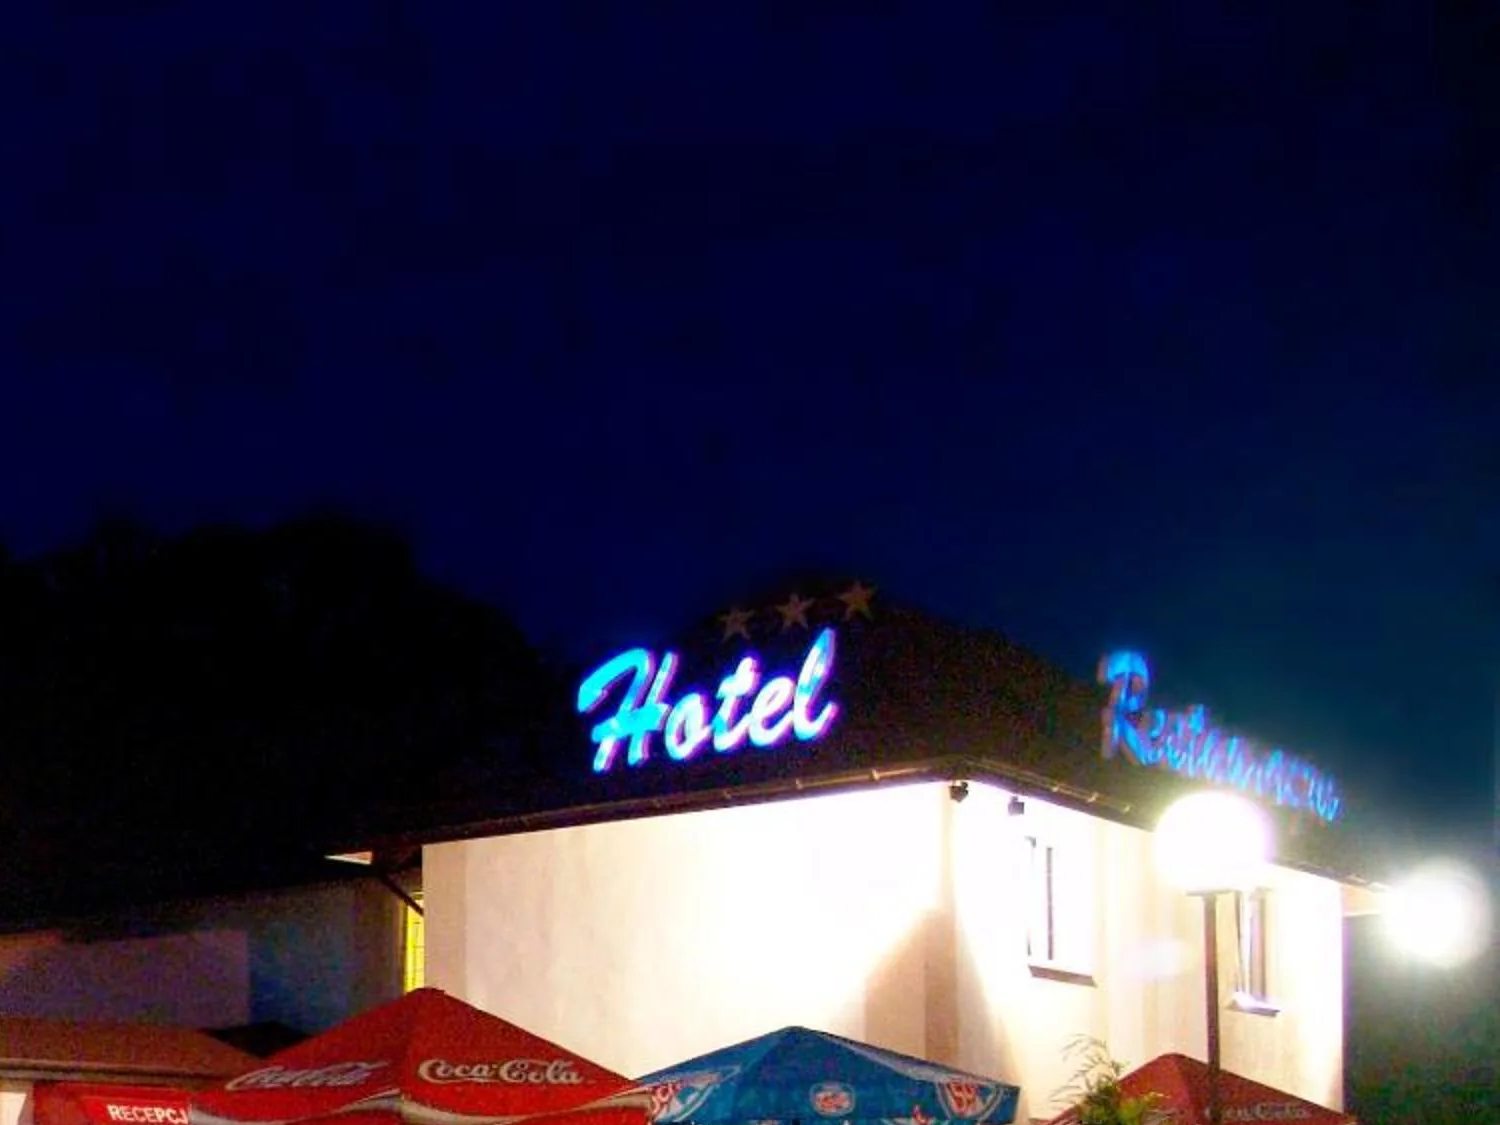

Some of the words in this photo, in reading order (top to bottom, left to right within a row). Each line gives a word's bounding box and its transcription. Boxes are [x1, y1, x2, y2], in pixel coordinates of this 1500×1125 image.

[577, 627, 838, 773] Hotel
[418, 1058, 583, 1085] Coca-Cola
[106, 1103, 190, 1125] RECEPCJ
